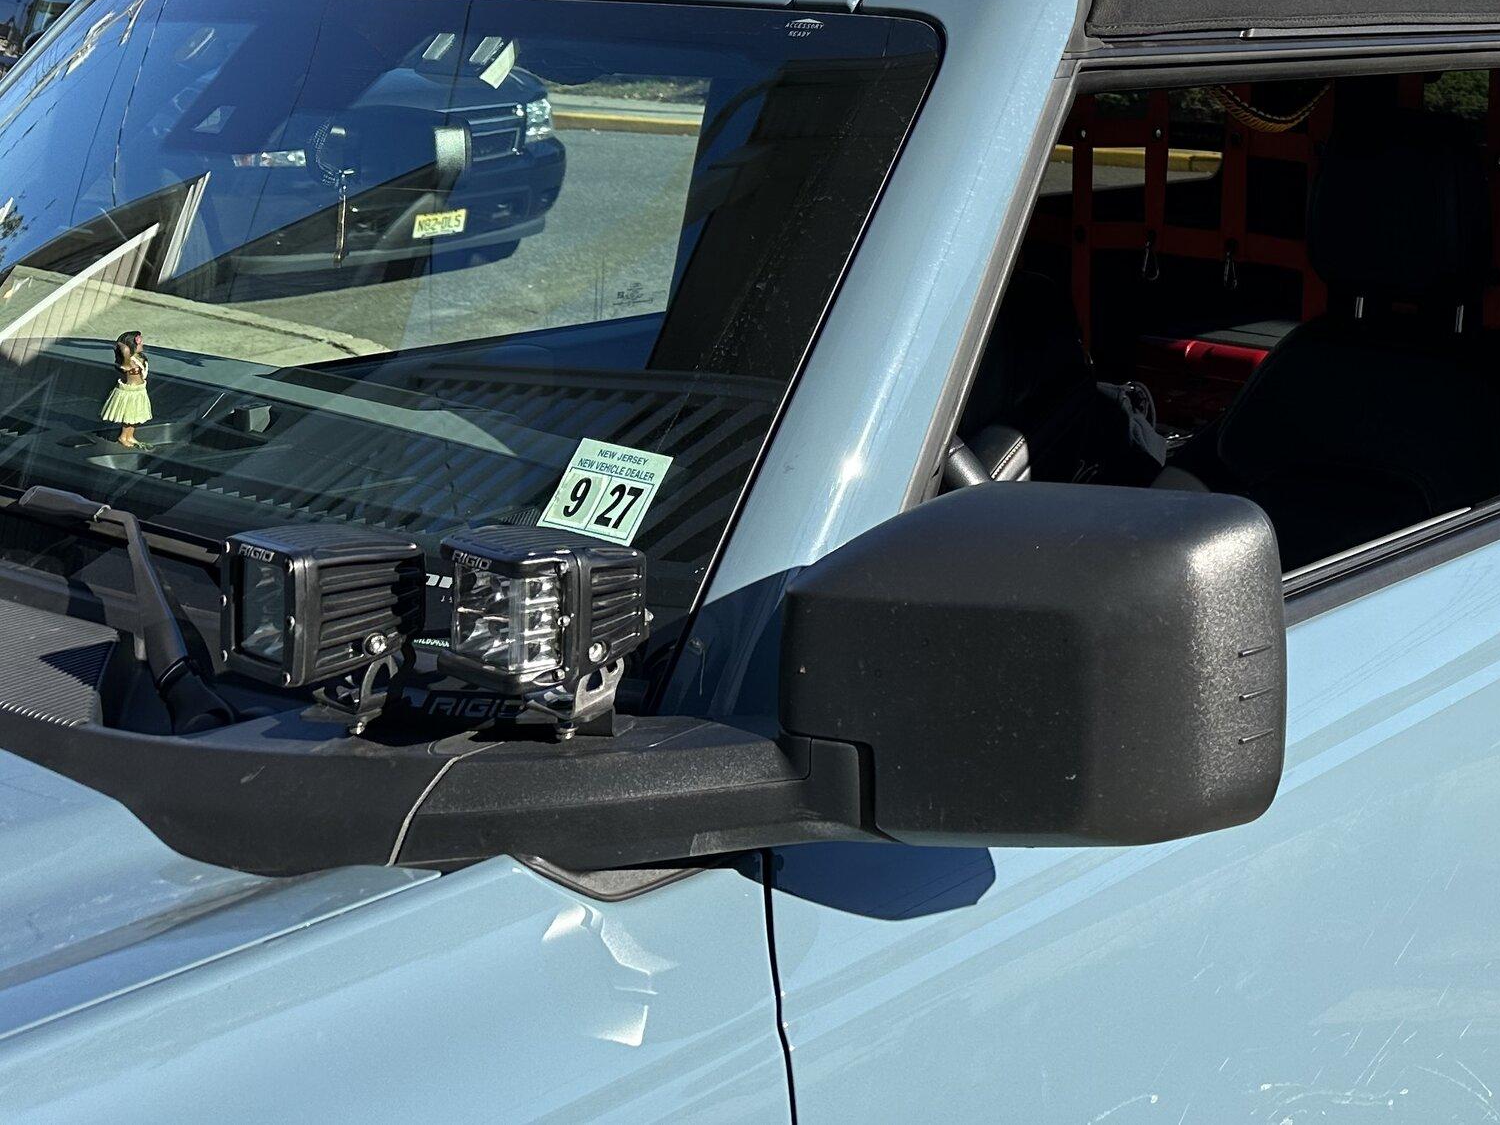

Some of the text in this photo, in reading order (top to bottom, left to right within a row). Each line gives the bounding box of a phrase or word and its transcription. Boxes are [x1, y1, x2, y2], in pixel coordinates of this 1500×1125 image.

[785, 22, 824, 30] ACCESSORY
[597, 449, 649, 466] NEW JERSEY
[577, 458, 655, 481] NEW VEHICLE DEALER
[563, 477, 644, 529] 9 27
[239, 543, 275, 563] RIGID
[452, 550, 493, 570] RIGID
